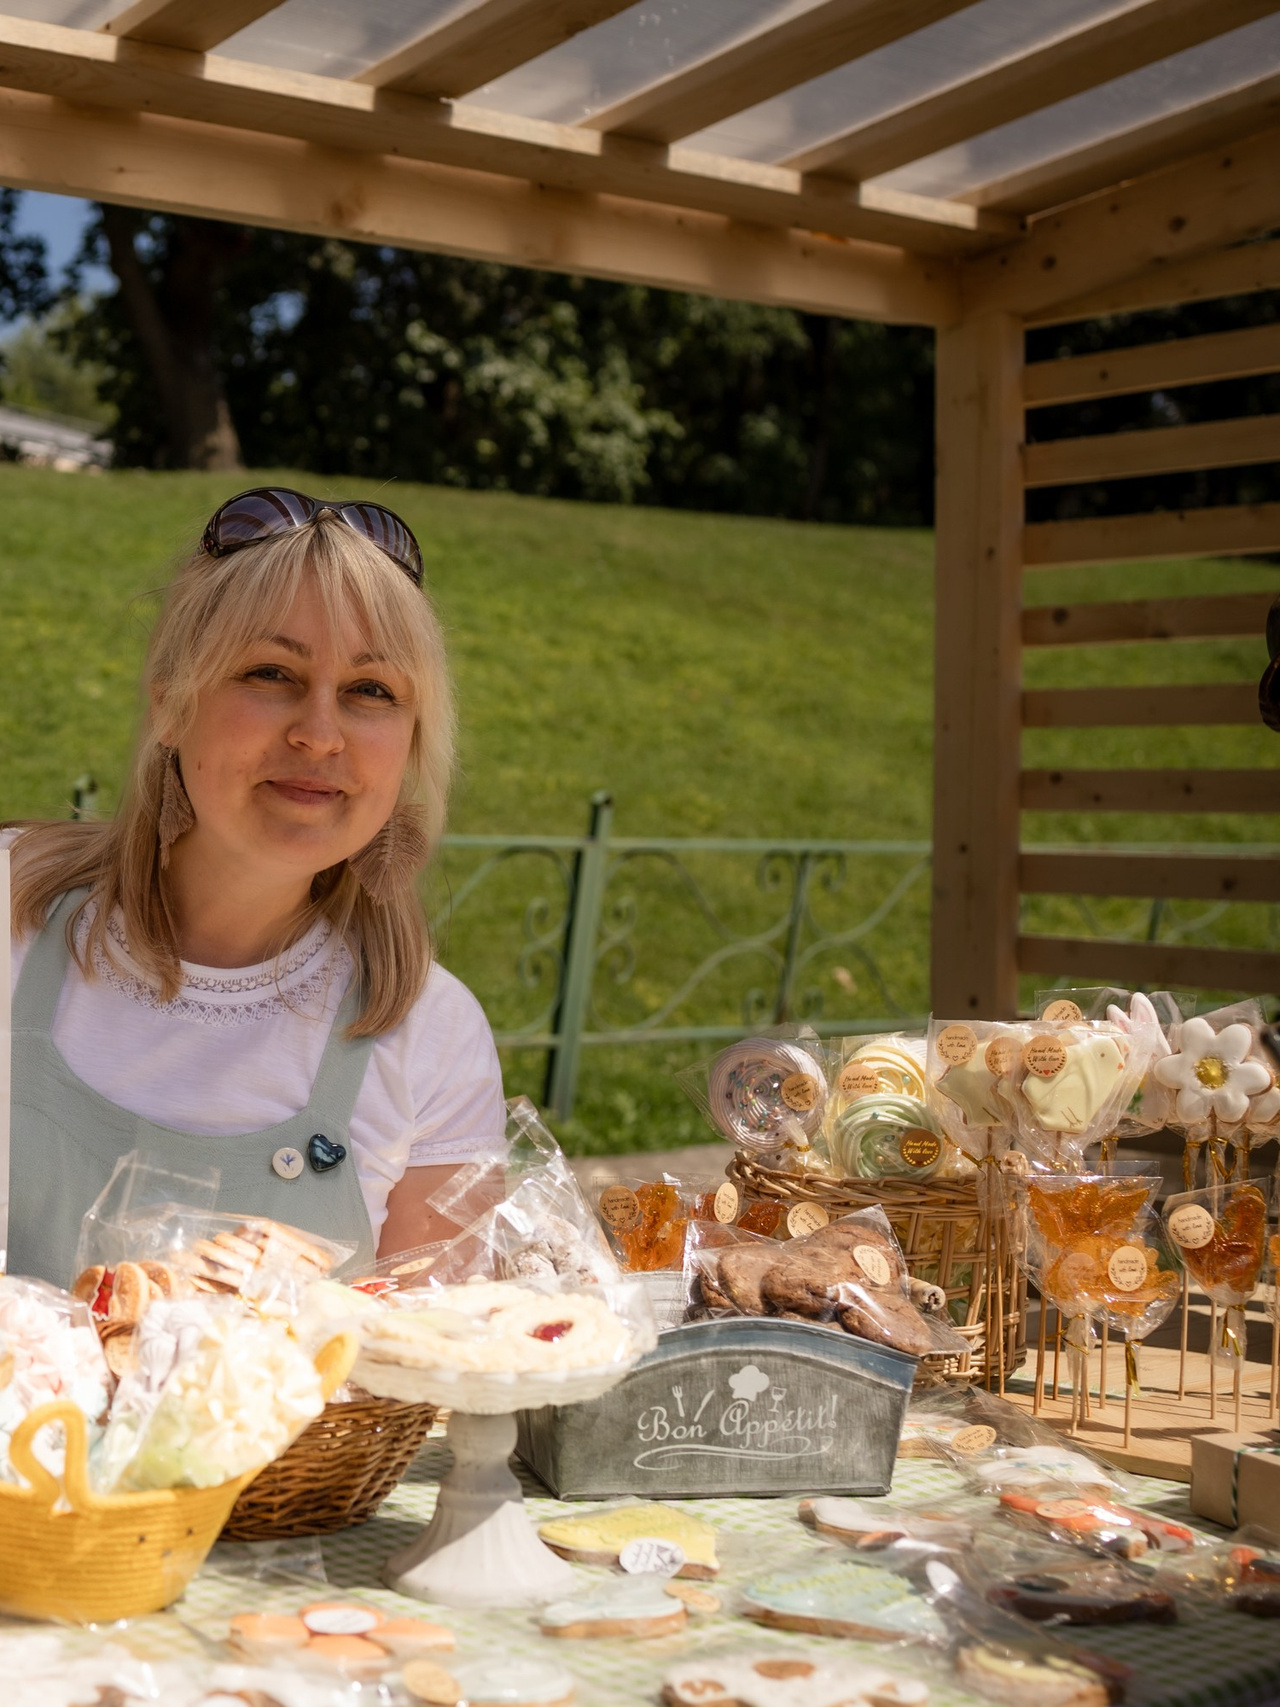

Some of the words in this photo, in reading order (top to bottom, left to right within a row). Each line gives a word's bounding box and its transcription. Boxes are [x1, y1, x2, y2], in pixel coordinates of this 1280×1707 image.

[1177, 1214, 1202, 1223] handmade
[637, 1406, 707, 1442] Bon
[719, 1394, 838, 1449] Appétit!
